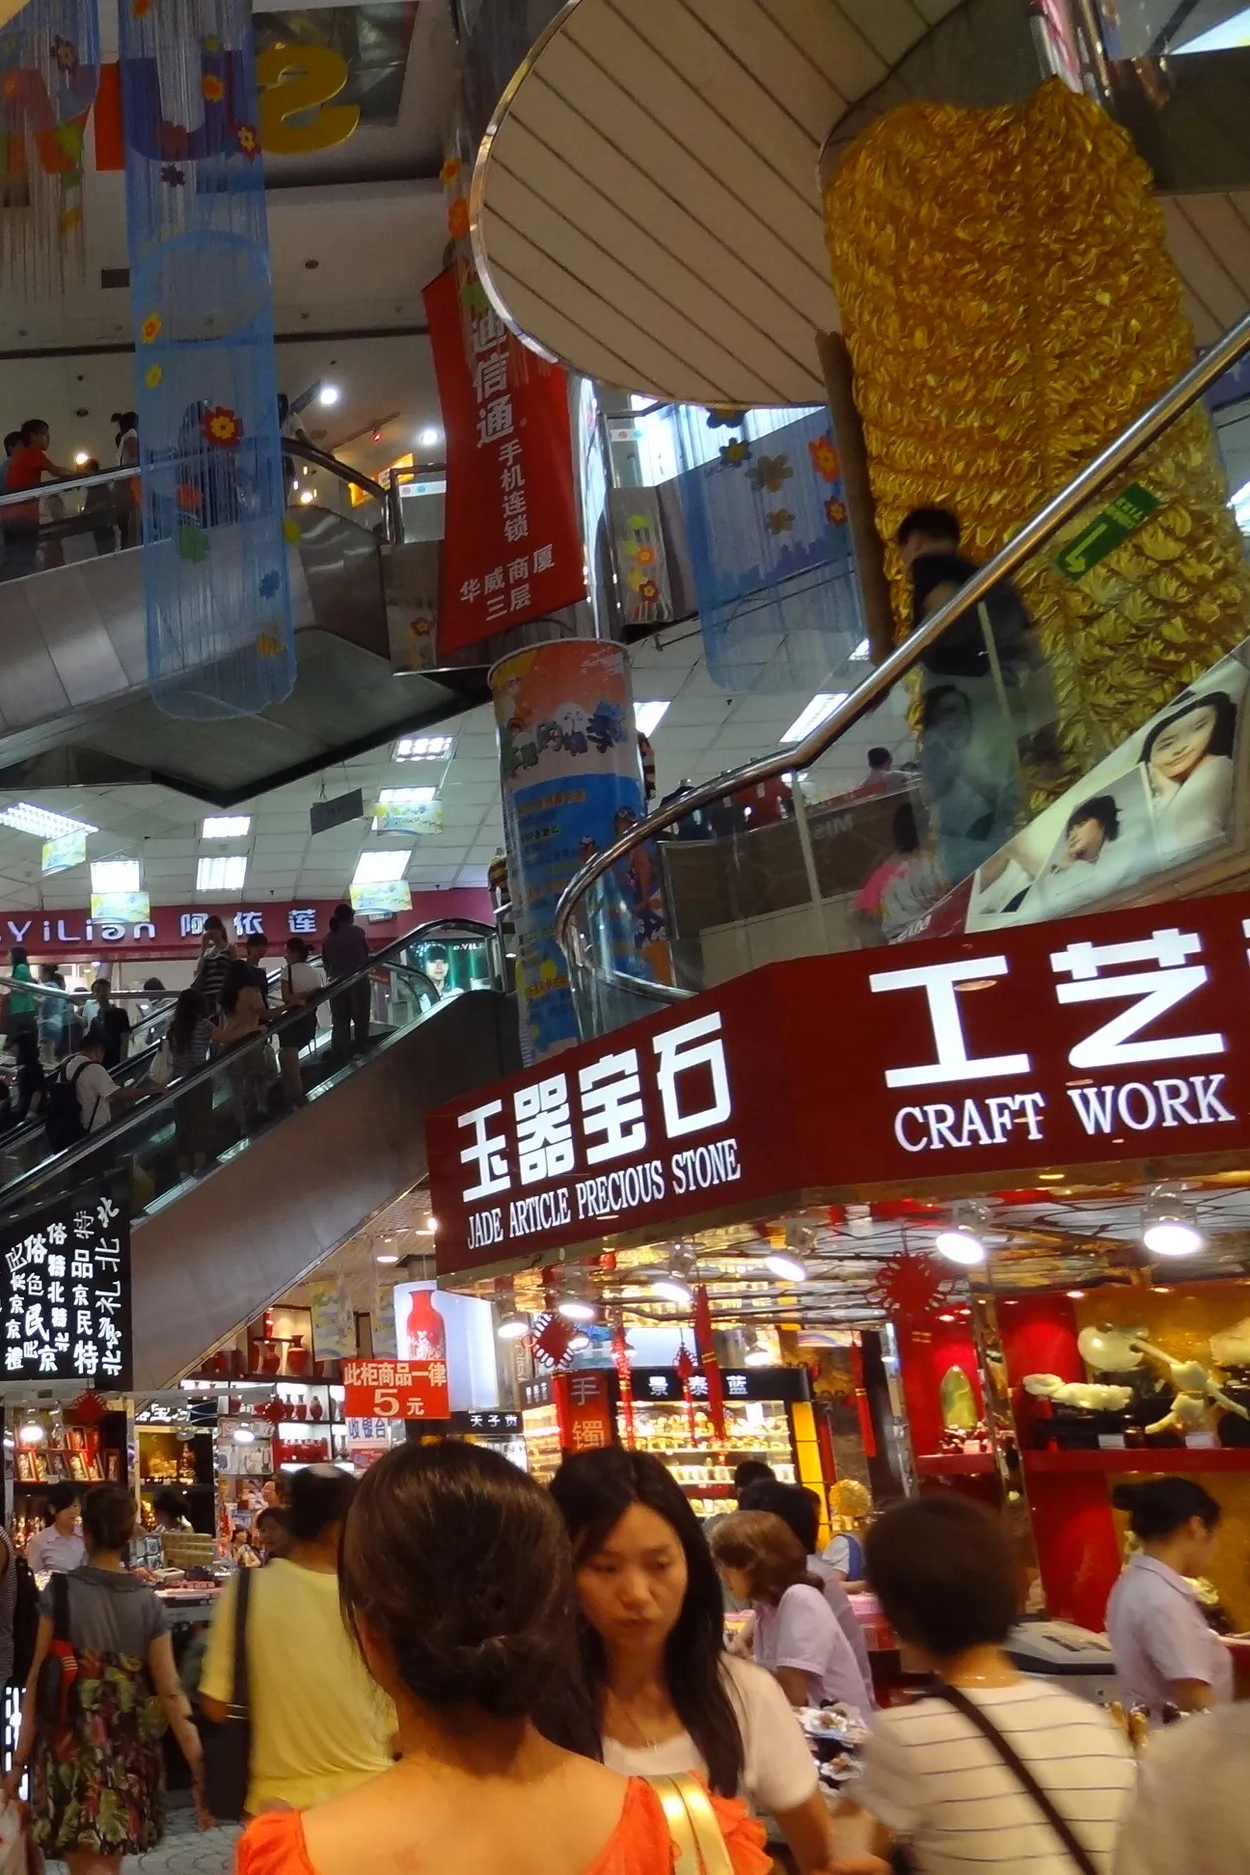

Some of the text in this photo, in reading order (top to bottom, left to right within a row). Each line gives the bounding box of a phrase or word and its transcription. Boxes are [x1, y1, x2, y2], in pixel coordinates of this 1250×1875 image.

[497, 438, 529, 544] 手机连锁
[459, 544, 555, 604] 华威商厦
[485, 588, 532, 623] 三层
[457, 1011, 732, 1203] 玉器宝石
[894, 1073, 1236, 1152] CRAFT WORK
[467, 1138, 741, 1250] JADE ARTICLE PRECIOUS STONE
[344, 1361, 447, 1387] 此柜商品一律
[373, 1388, 425, 1417] 5 元
[648, 1374, 748, 1398] 景泰蓝
[348, 1417, 386, 1439] 收银台
[571, 1376, 605, 1450] 手镯
